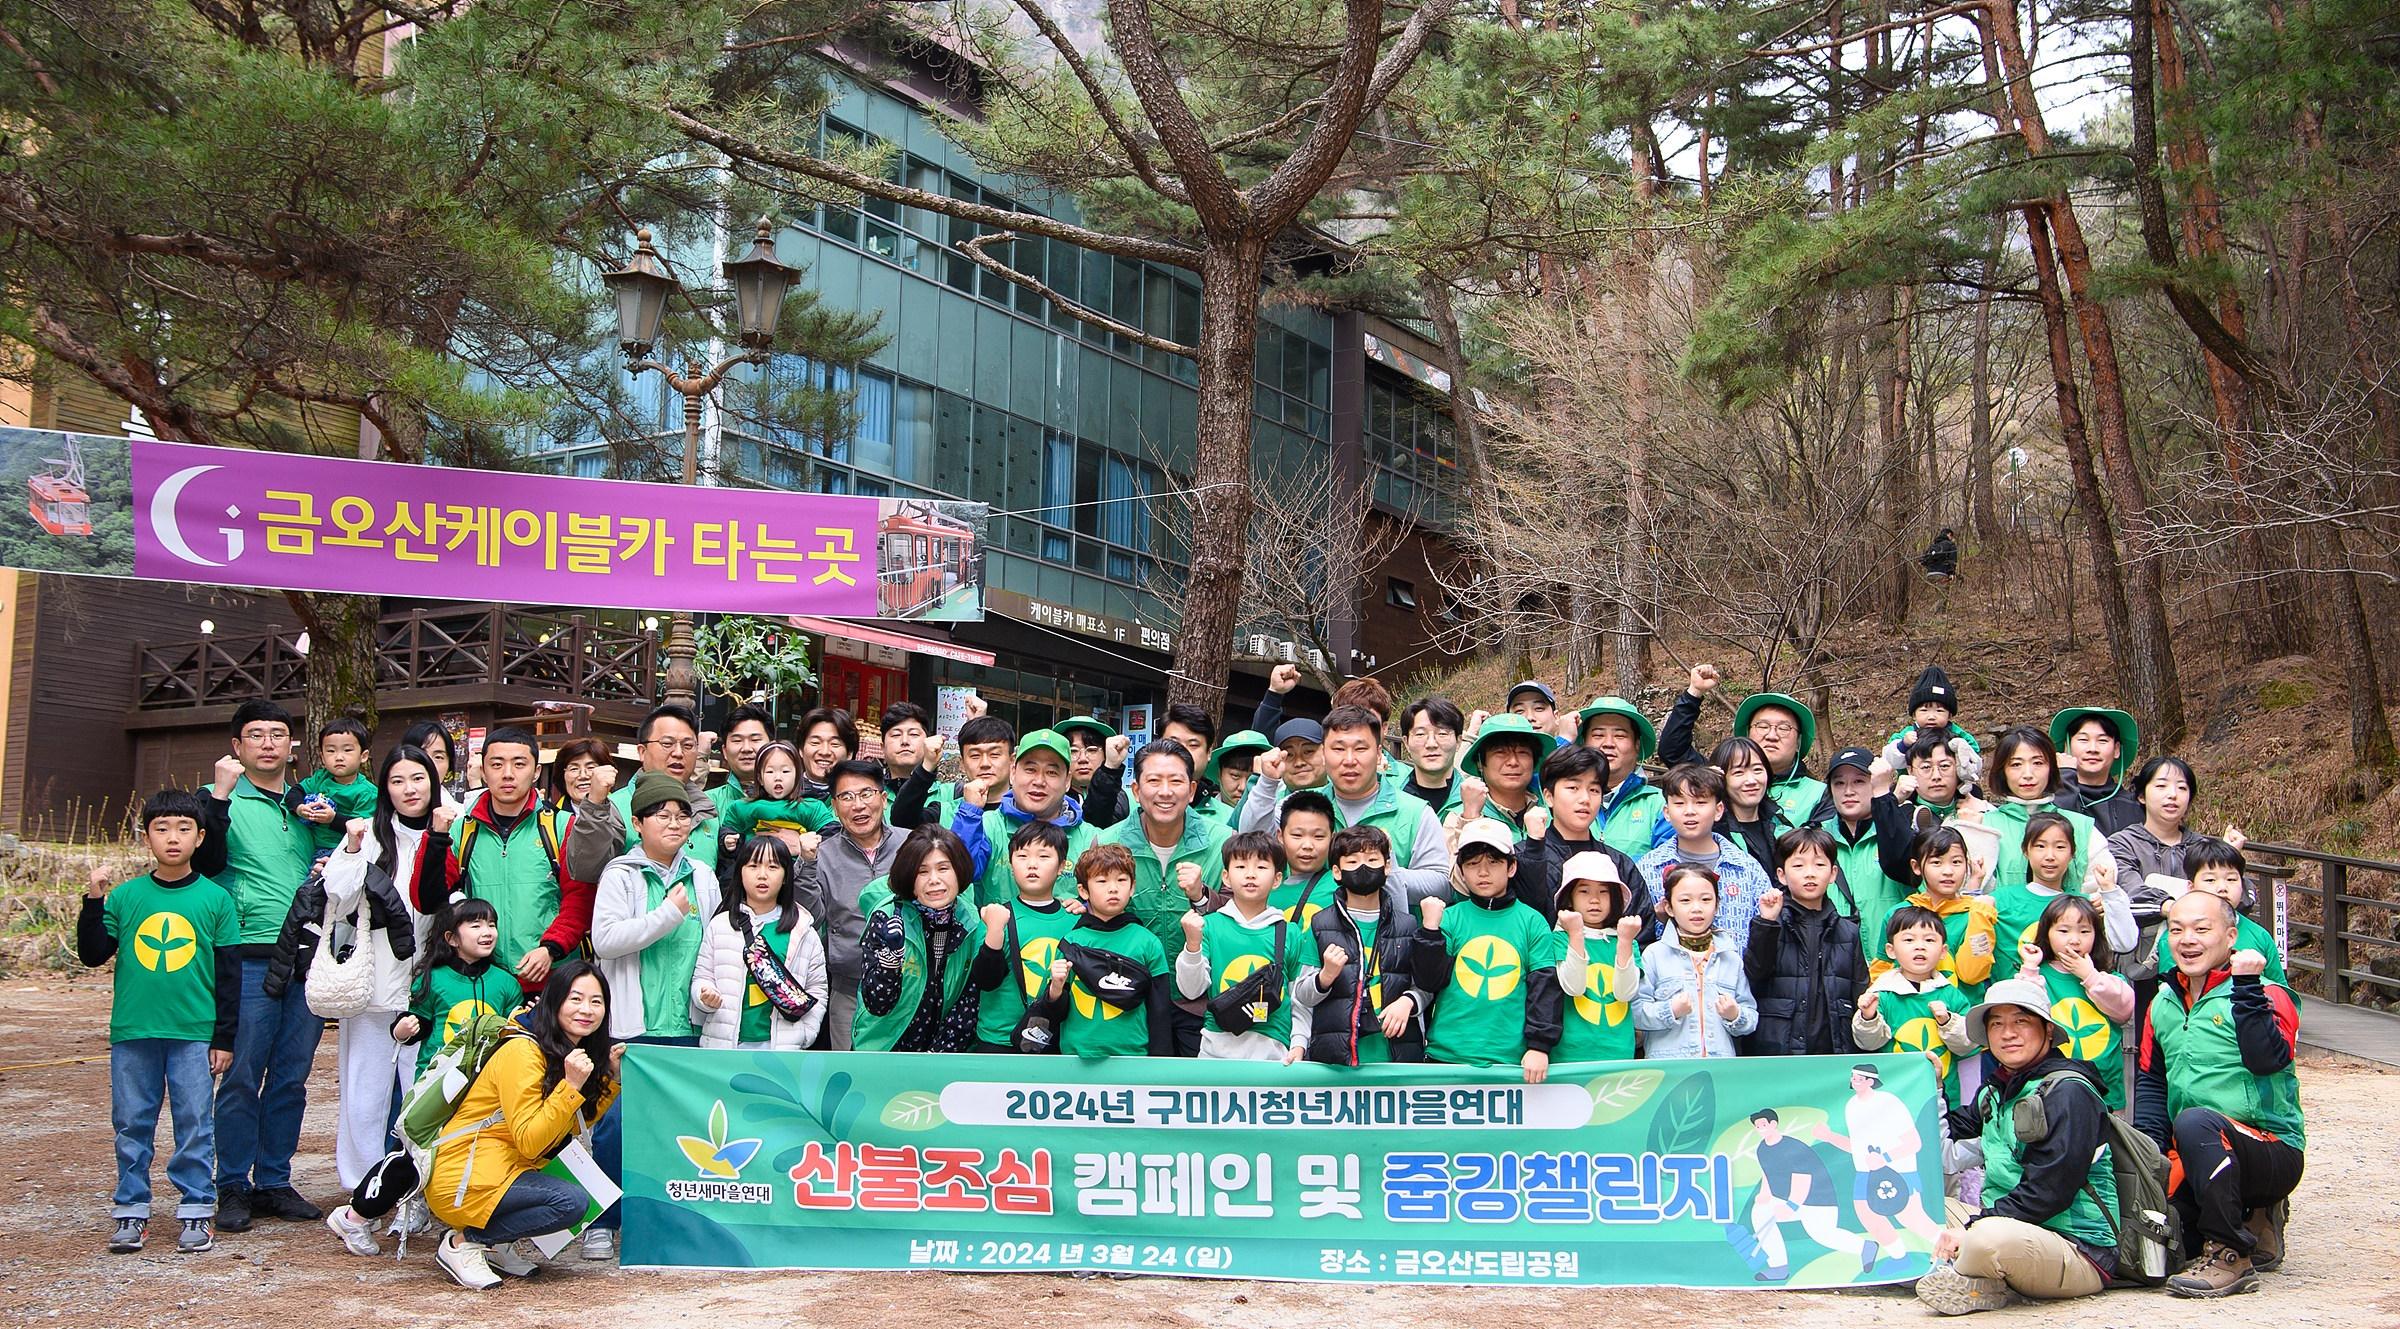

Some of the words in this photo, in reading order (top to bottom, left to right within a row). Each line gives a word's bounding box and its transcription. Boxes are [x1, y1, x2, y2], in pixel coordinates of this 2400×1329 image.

[259, 491, 673, 575] 금오산케이블카
[693, 519, 859, 586] 타는곳
[1029, 602, 1074, 629] 케이블카
[1076, 613, 1106, 634] 매표소
[1114, 627, 1126, 641] 1F
[1140, 627, 1171, 651] 편의점
[1006, 1089, 1135, 1124] 2024년
[1147, 1088, 1523, 1125] 구미시청년새마을연대
[668, 1182, 770, 1202] 청년새마을연대
[790, 1142, 1053, 1215] 산불조심
[1074, 1151, 1274, 1218] 캠페인
[1297, 1153, 1363, 1219] 및
[1384, 1152, 1735, 1223] 줍깅챌린지
[909, 1239, 959, 1264] 날짜
[966, 1244, 973, 1261] :
[980, 1241, 1051, 1265] 2024
[1060, 1243, 1084, 1264] 년
[1091, 1244, 1133, 1265] 3월
[1141, 1245, 1177, 1266] 24
[1185, 1246, 1233, 1269] (일)
[1320, 1249, 1371, 1273] 장소
[1379, 1254, 1386, 1271] :
[1395, 1250, 1579, 1278] 금오산도립공원
